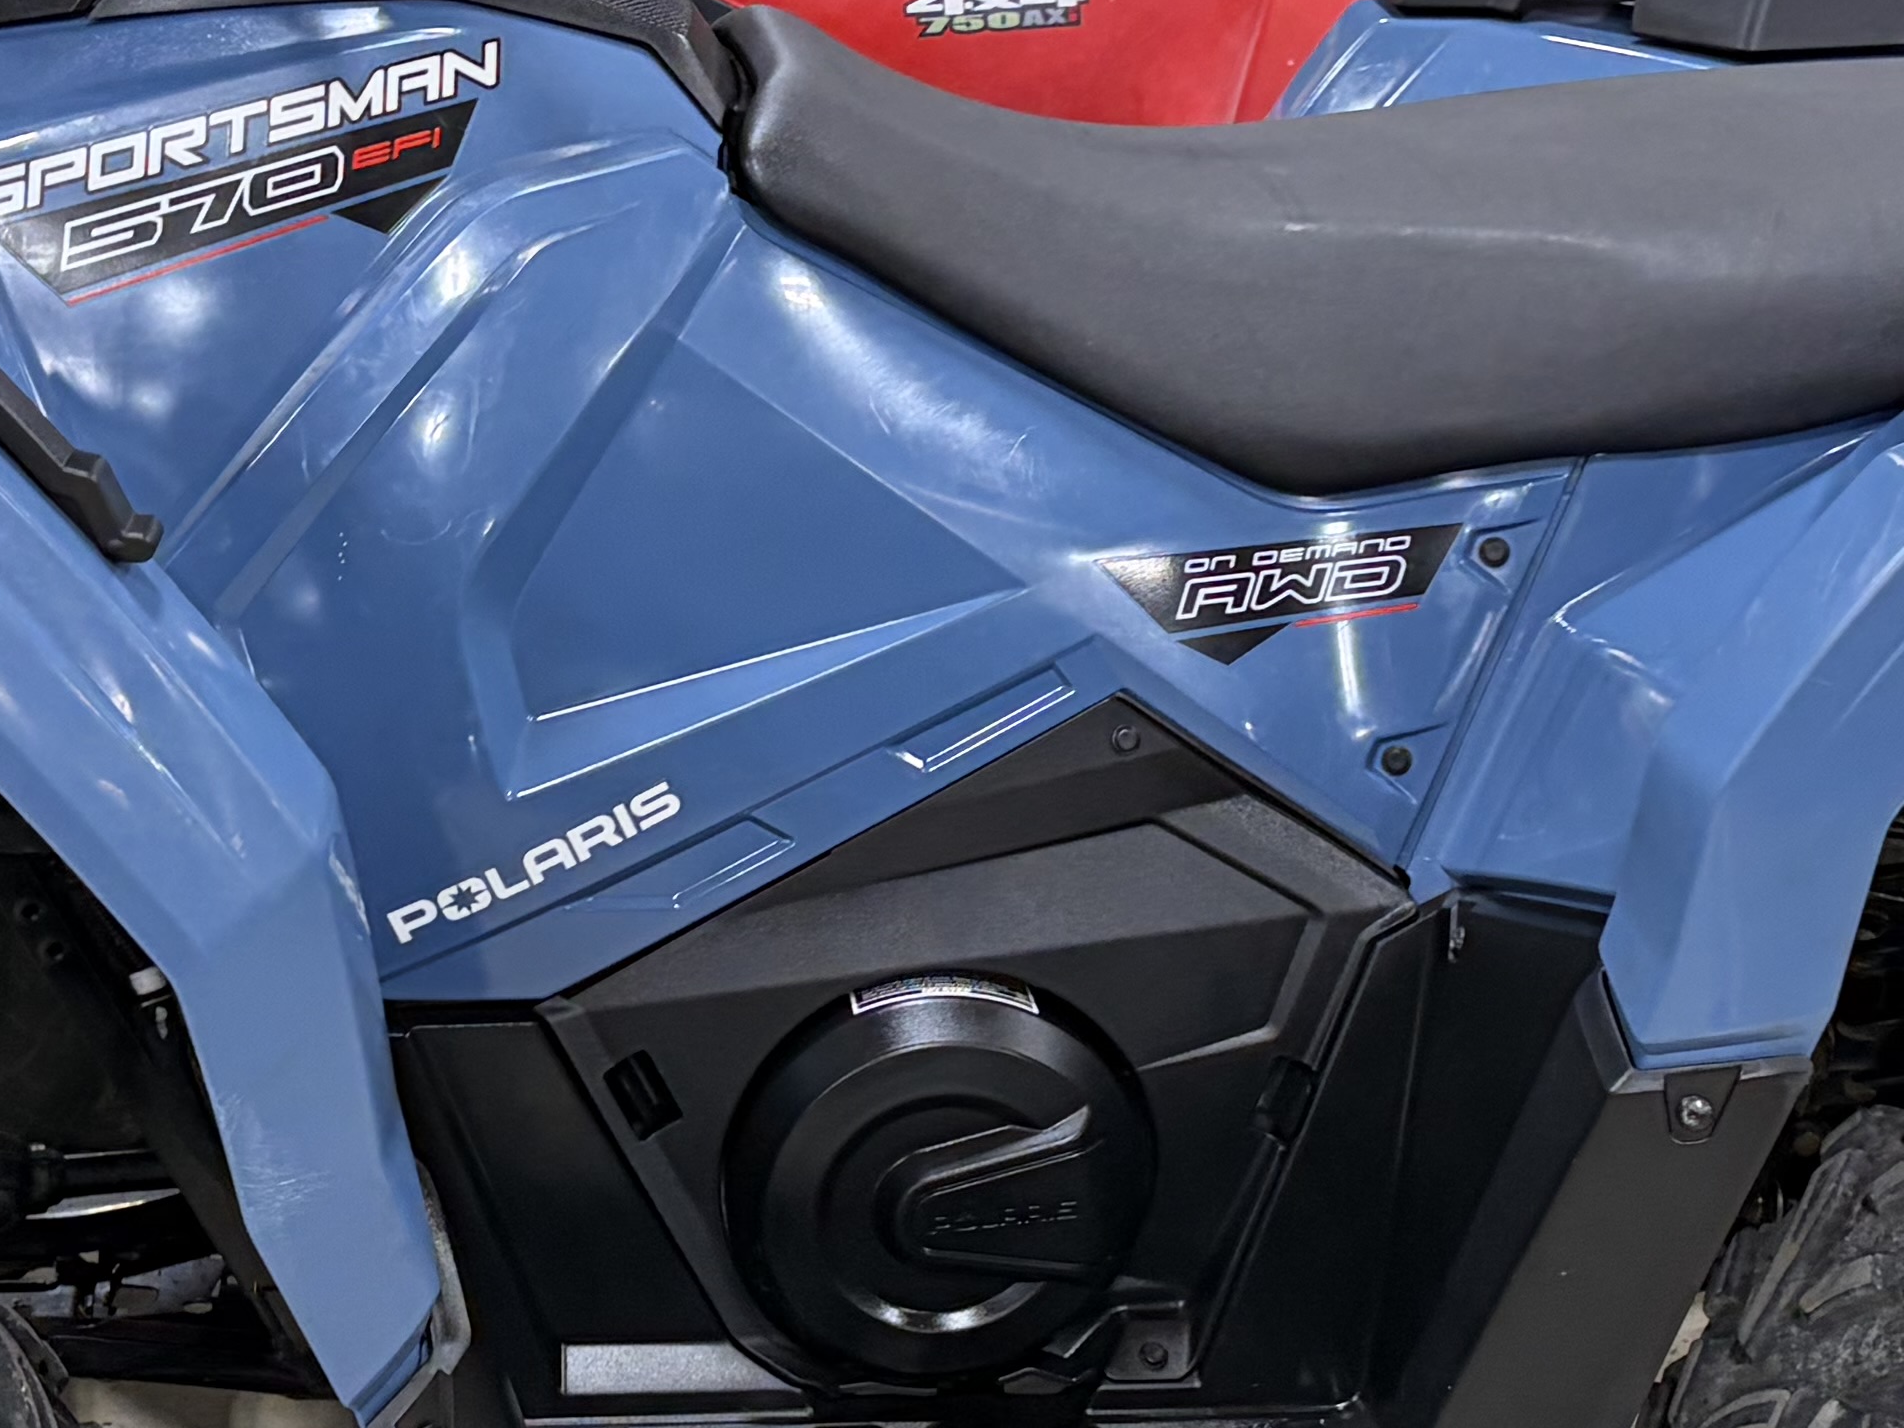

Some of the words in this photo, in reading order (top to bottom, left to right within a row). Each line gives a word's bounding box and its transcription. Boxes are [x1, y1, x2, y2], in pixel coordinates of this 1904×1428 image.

[61, 145, 344, 272] 570
[351, 126, 442, 171] EFI
[1175, 555, 1407, 621] AWD
[1251, 535, 1412, 568] DEMAND
[386, 780, 682, 945] POLARIS
